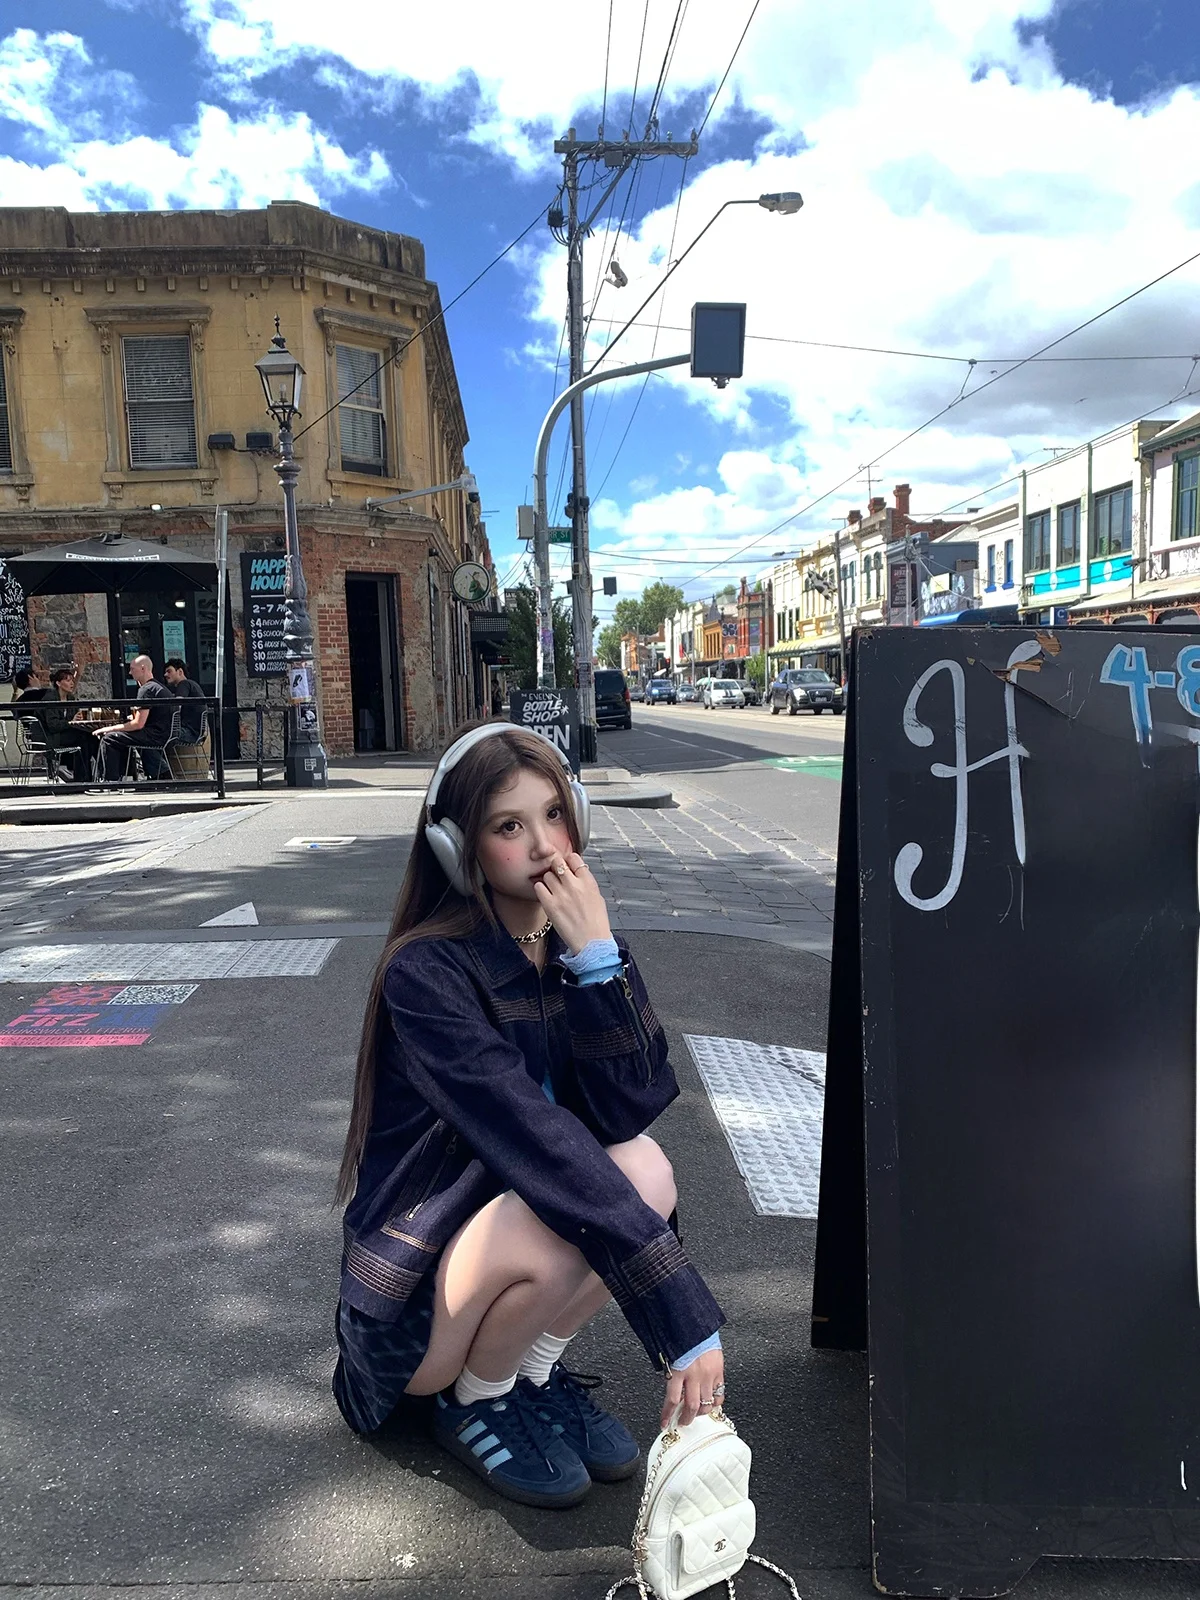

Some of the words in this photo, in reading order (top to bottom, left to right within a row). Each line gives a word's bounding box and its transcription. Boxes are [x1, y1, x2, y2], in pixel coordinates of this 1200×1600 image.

[251, 559, 287, 573] HAPP
[252, 604, 274, 613] 2-7
[250, 618, 262, 628] $4
[251, 629, 263, 639] $6
[252, 640, 264, 650] $6
[253, 651, 266, 660] $10
[254, 662, 266, 671] $10
[528, 692, 561, 700] EVELYN
[522, 699, 563, 711] BOTTLE
[522, 711, 560, 723] SHOP
[523, 724, 570, 750] PEN
